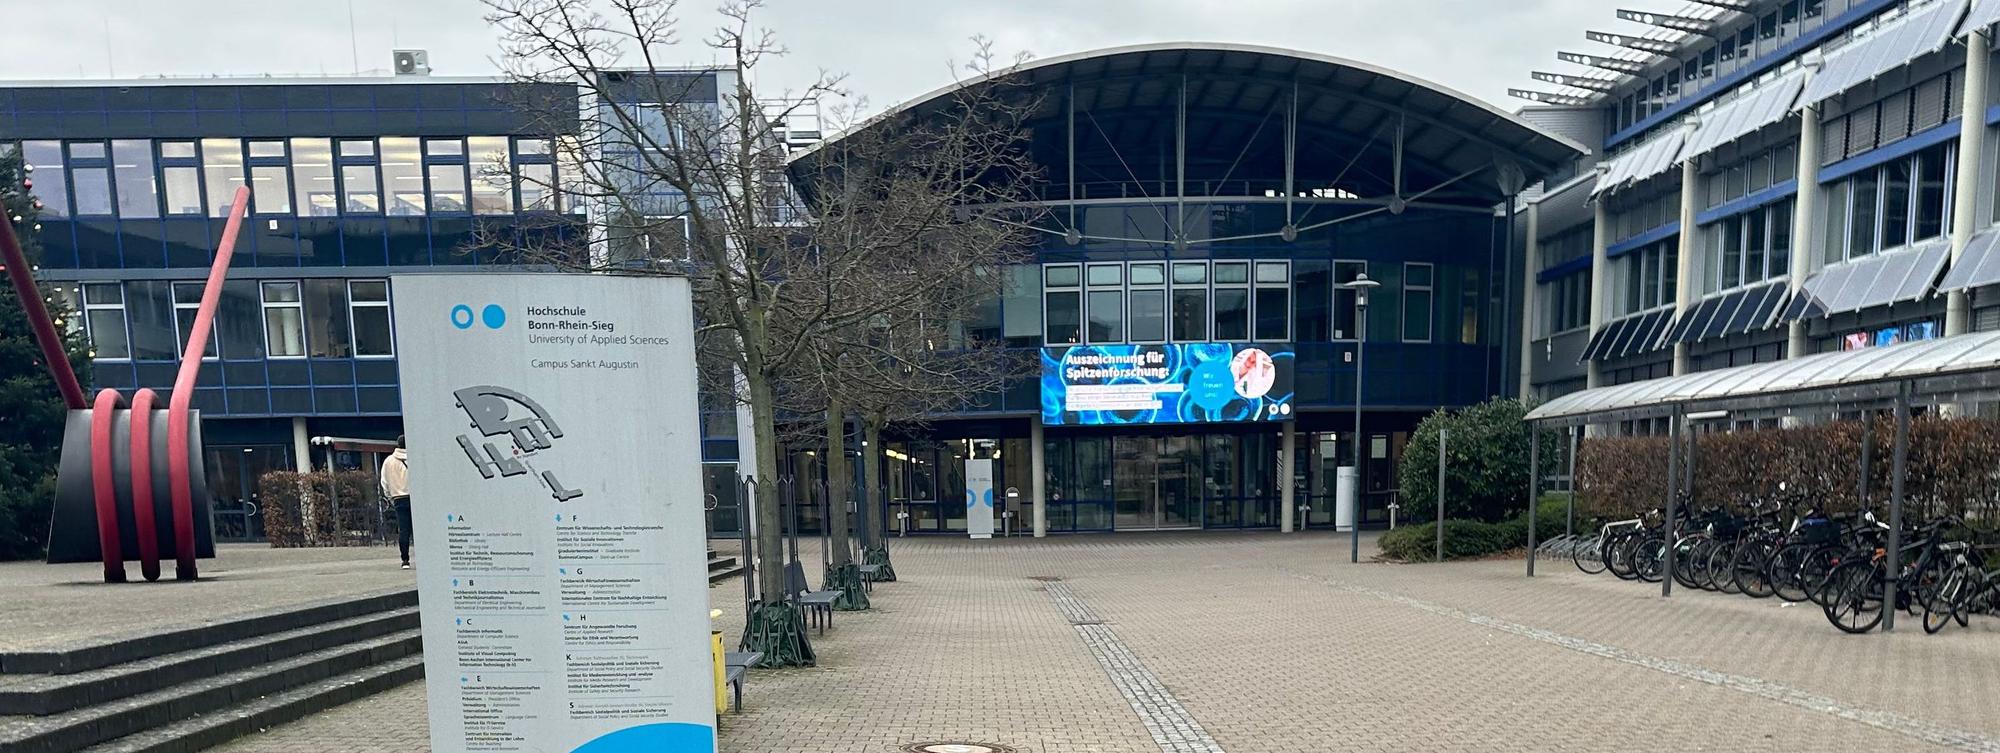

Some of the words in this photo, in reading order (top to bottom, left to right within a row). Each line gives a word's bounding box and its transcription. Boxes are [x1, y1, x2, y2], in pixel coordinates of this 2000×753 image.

[527, 307, 586, 316] Hochschule
[528, 320, 614, 332] Bonn-Rhein-Sieg
[529, 334, 574, 345] University
[577, 334, 587, 345] of
[591, 334, 626, 345] Applied
[630, 334, 668, 345] Sciences
[1066, 354, 1145, 365] Auszeichnung
[1147, 352, 1164, 364] für
[531, 360, 568, 370] Campus
[571, 360, 596, 370] Sankt
[599, 360, 638, 370] Augustin
[1066, 368, 1169, 379] Spitzenforschung:
